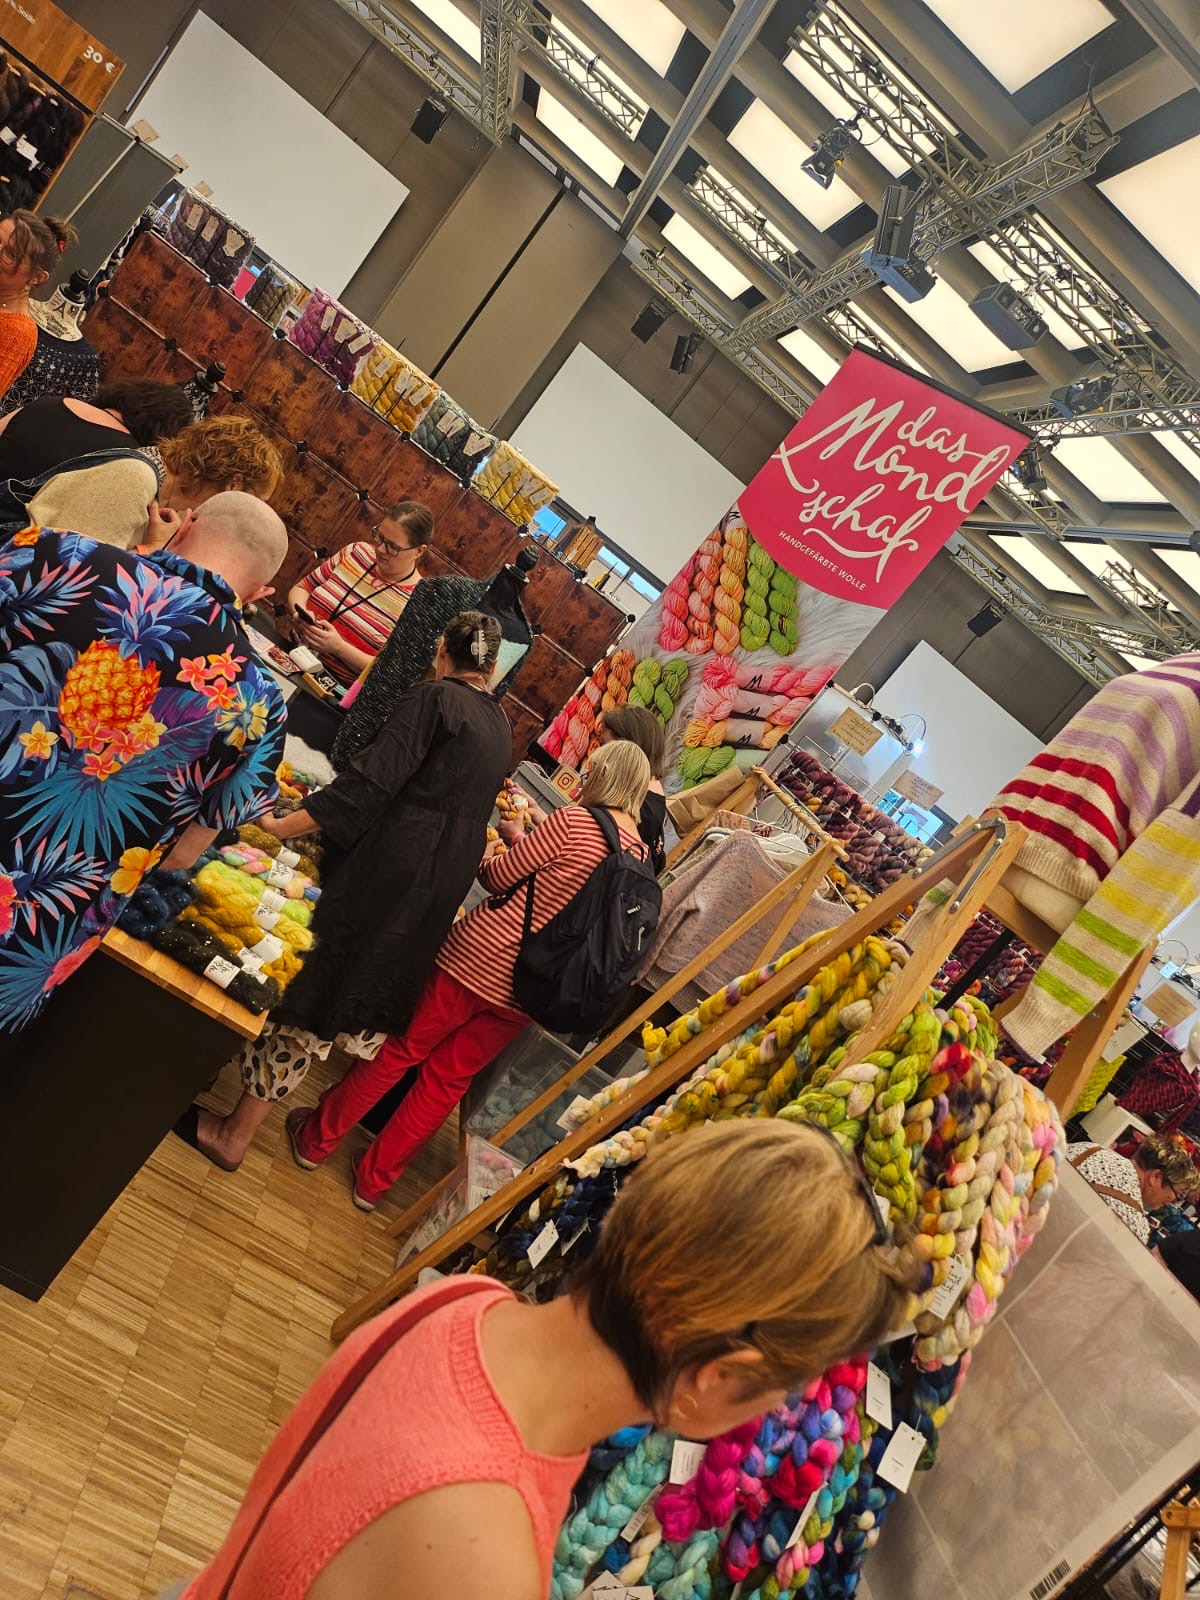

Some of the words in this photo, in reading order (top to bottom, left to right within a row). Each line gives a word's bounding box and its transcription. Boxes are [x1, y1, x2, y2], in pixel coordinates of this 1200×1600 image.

[83, 45, 103, 63] 30
[772, 397, 1011, 514] Mond
[897, 406, 980, 462] das
[778, 530, 839, 573] HANDGEFÄRBTE
[838, 569, 867, 591] WOLLE
[799, 484, 933, 584] schaf
